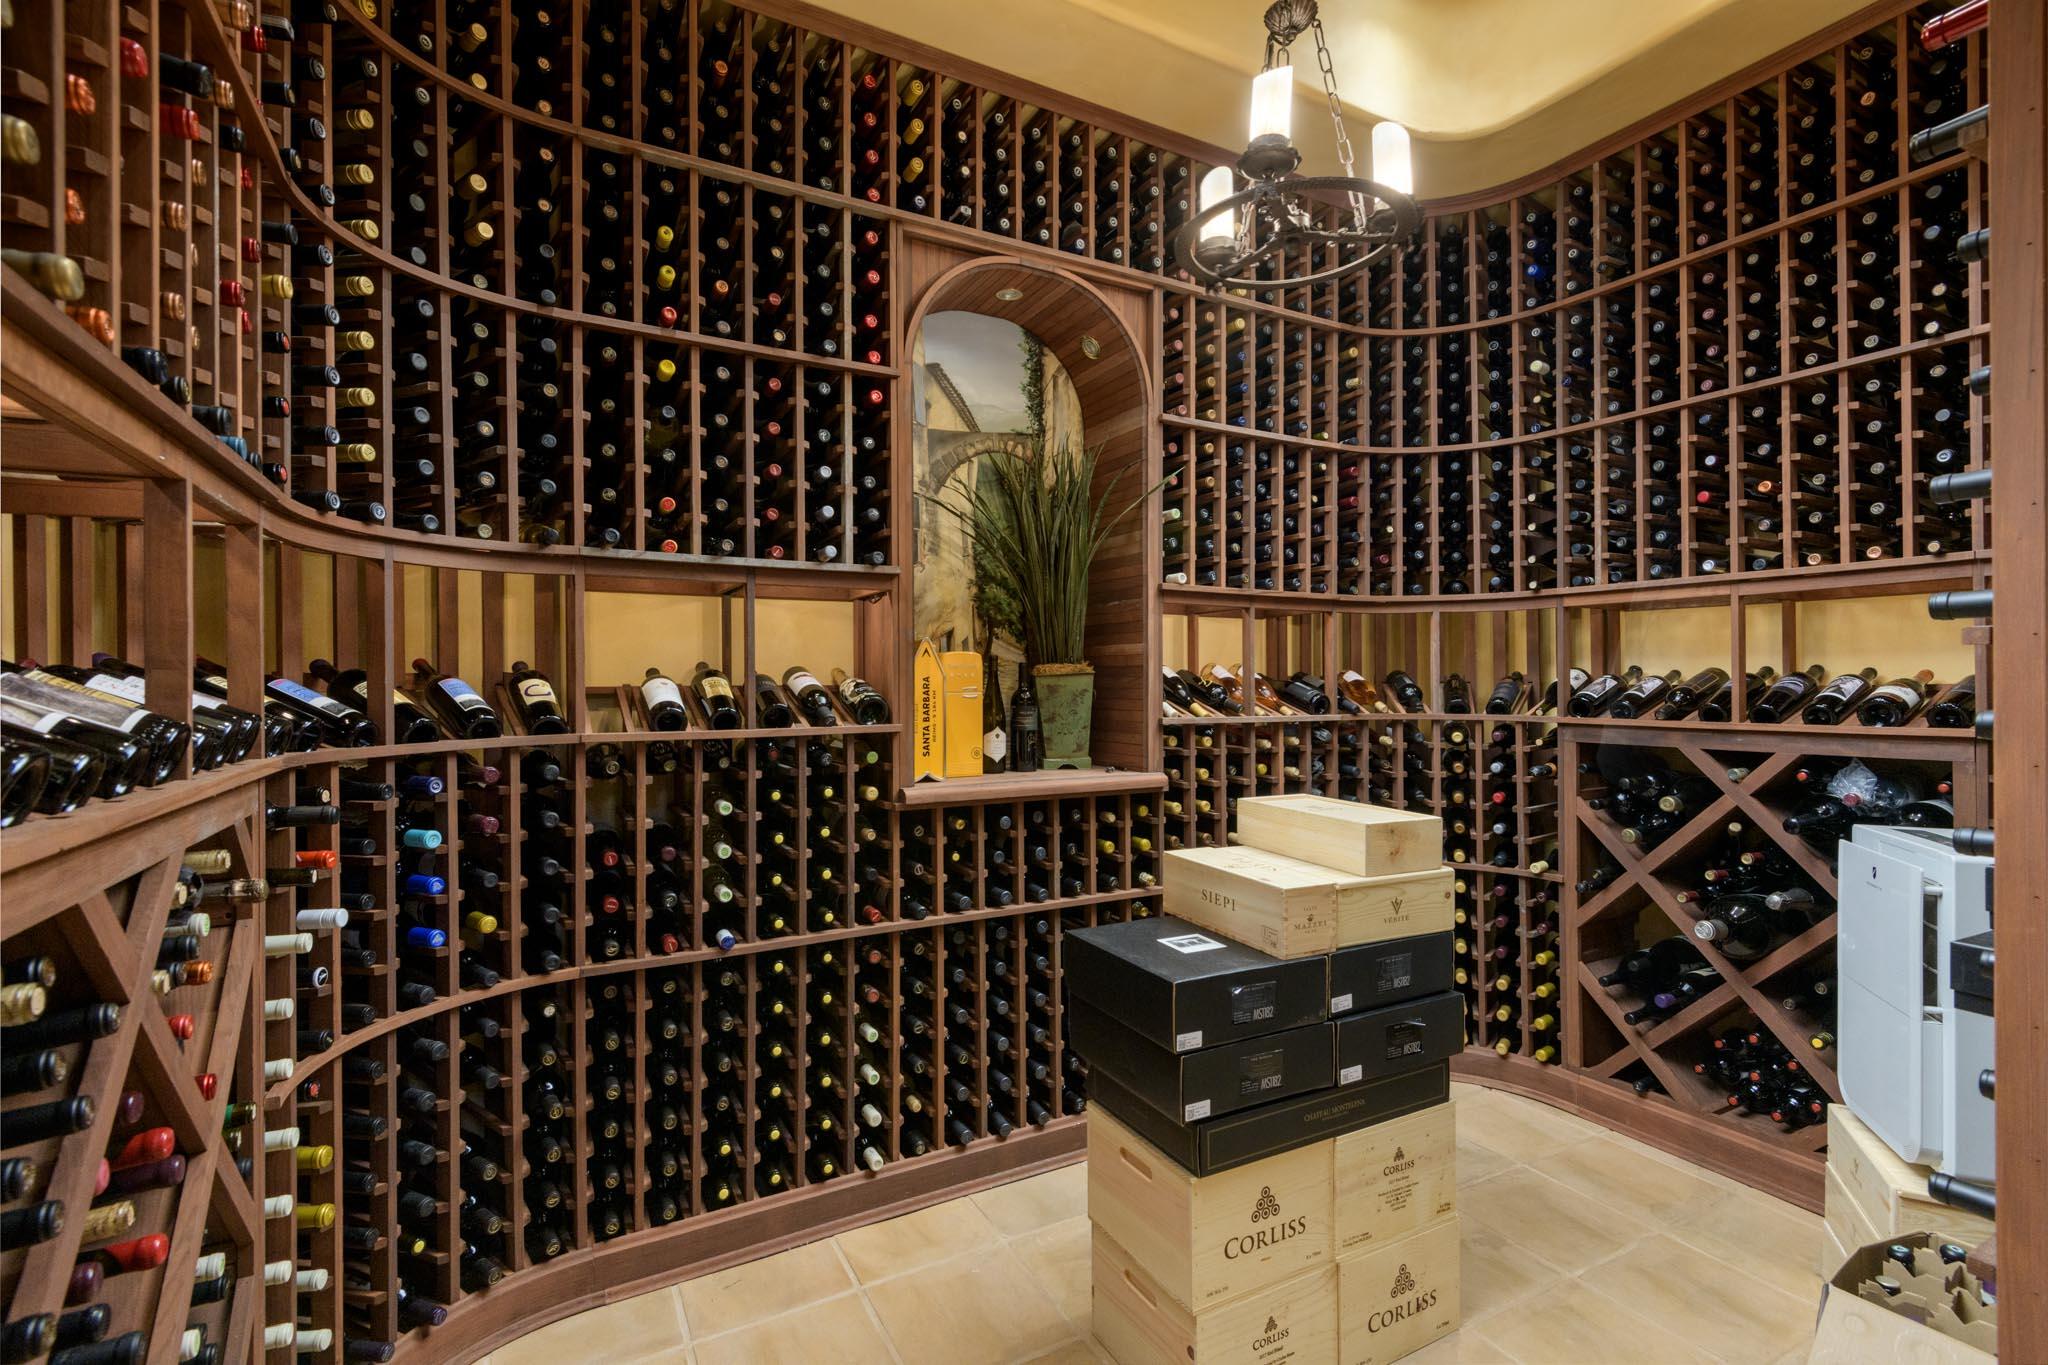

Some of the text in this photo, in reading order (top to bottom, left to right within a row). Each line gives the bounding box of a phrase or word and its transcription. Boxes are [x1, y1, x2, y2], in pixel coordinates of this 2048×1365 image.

[922, 676, 930, 757] SANTA BARBARA
[1201, 889, 1236, 912] SIEPI
[1383, 1159, 1415, 1177] CORLISS
[1223, 1215, 1307, 1260] CORLISS
[1367, 1289, 1437, 1333] CORLISS
[1252, 1328, 1290, 1351] CORLISS
